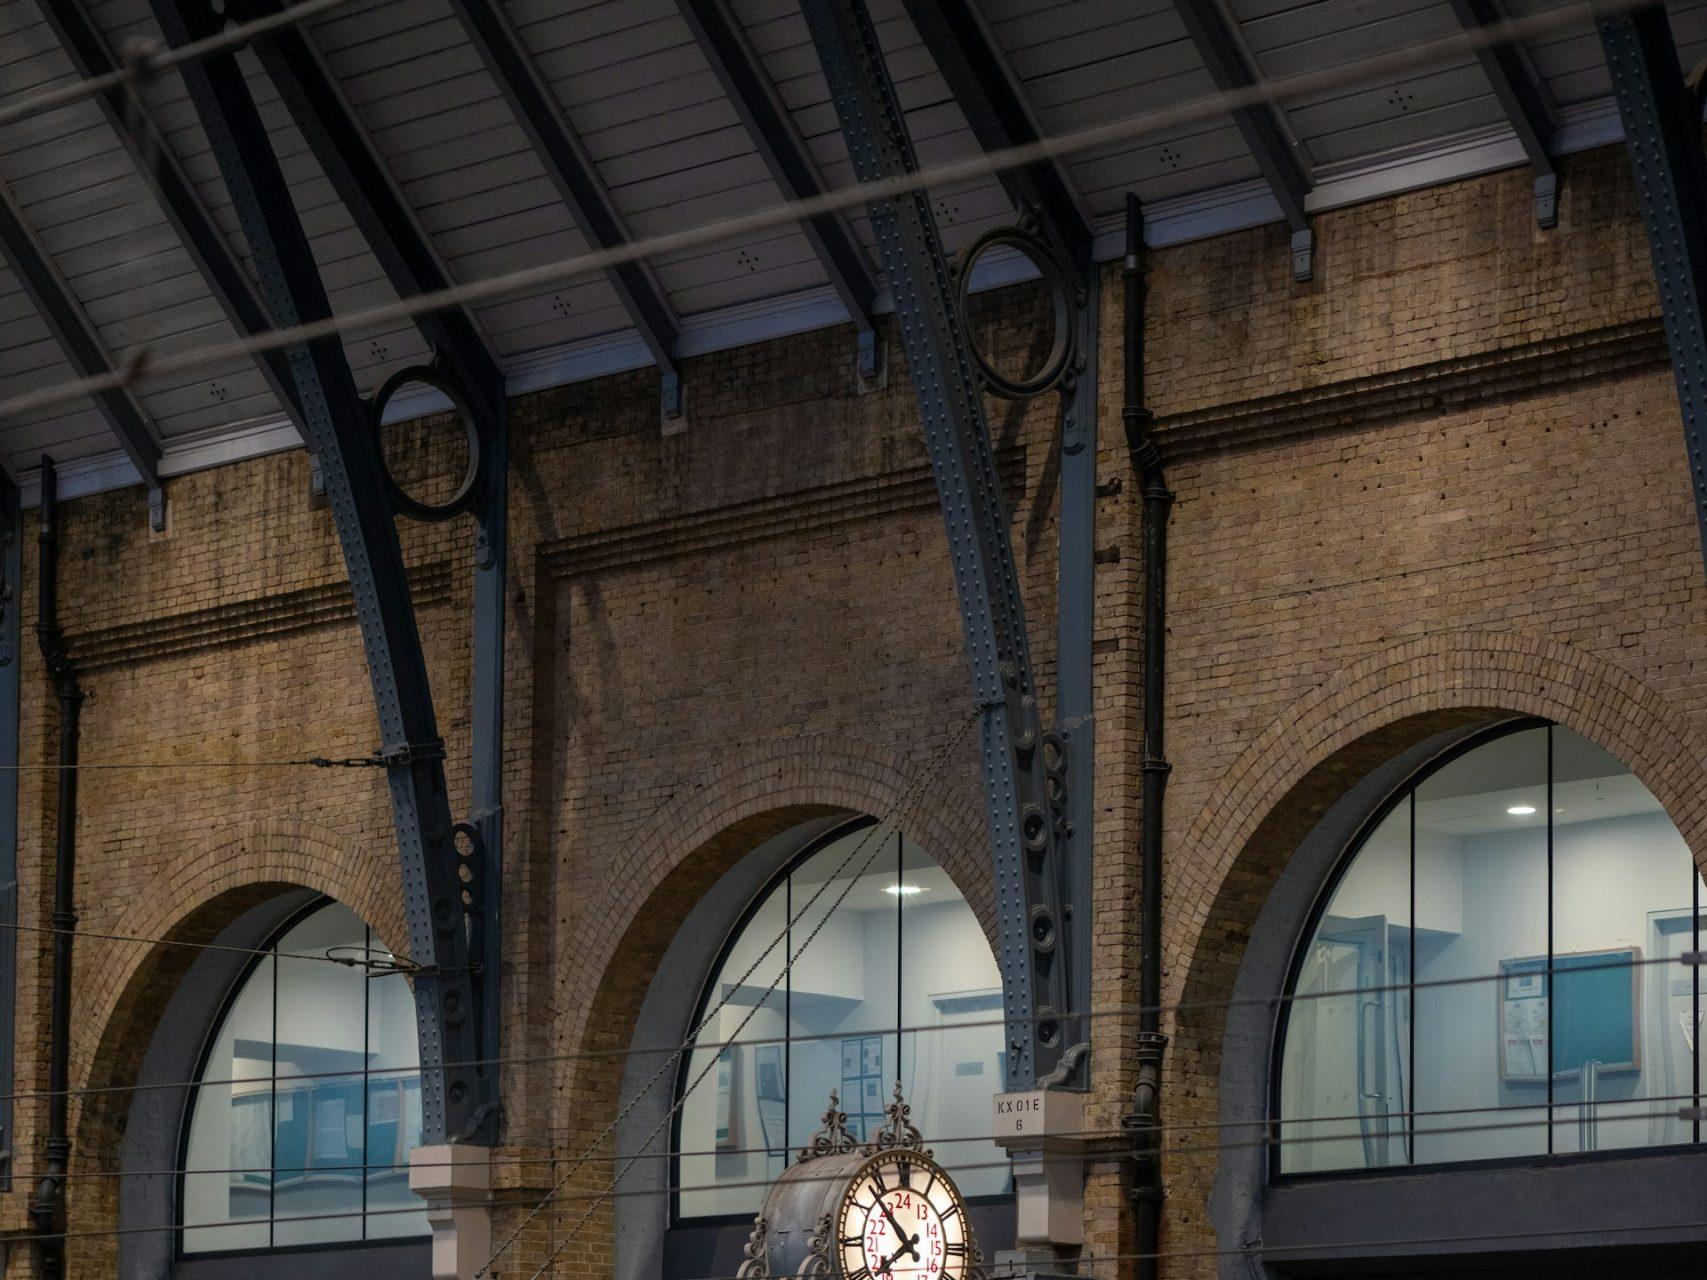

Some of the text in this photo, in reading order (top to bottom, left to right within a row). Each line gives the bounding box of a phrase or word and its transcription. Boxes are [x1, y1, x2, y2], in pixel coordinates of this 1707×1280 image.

[1016, 1119, 1023, 1131] 6
[894, 1193, 911, 1209] 24
[917, 1204, 928, 1220] 13
[869, 1219, 886, 1235] 22
[926, 1222, 938, 1238] 14
[866, 1236, 878, 1252] 21
[930, 1240, 942, 1256] 15
[926, 1257, 938, 1273] 16
